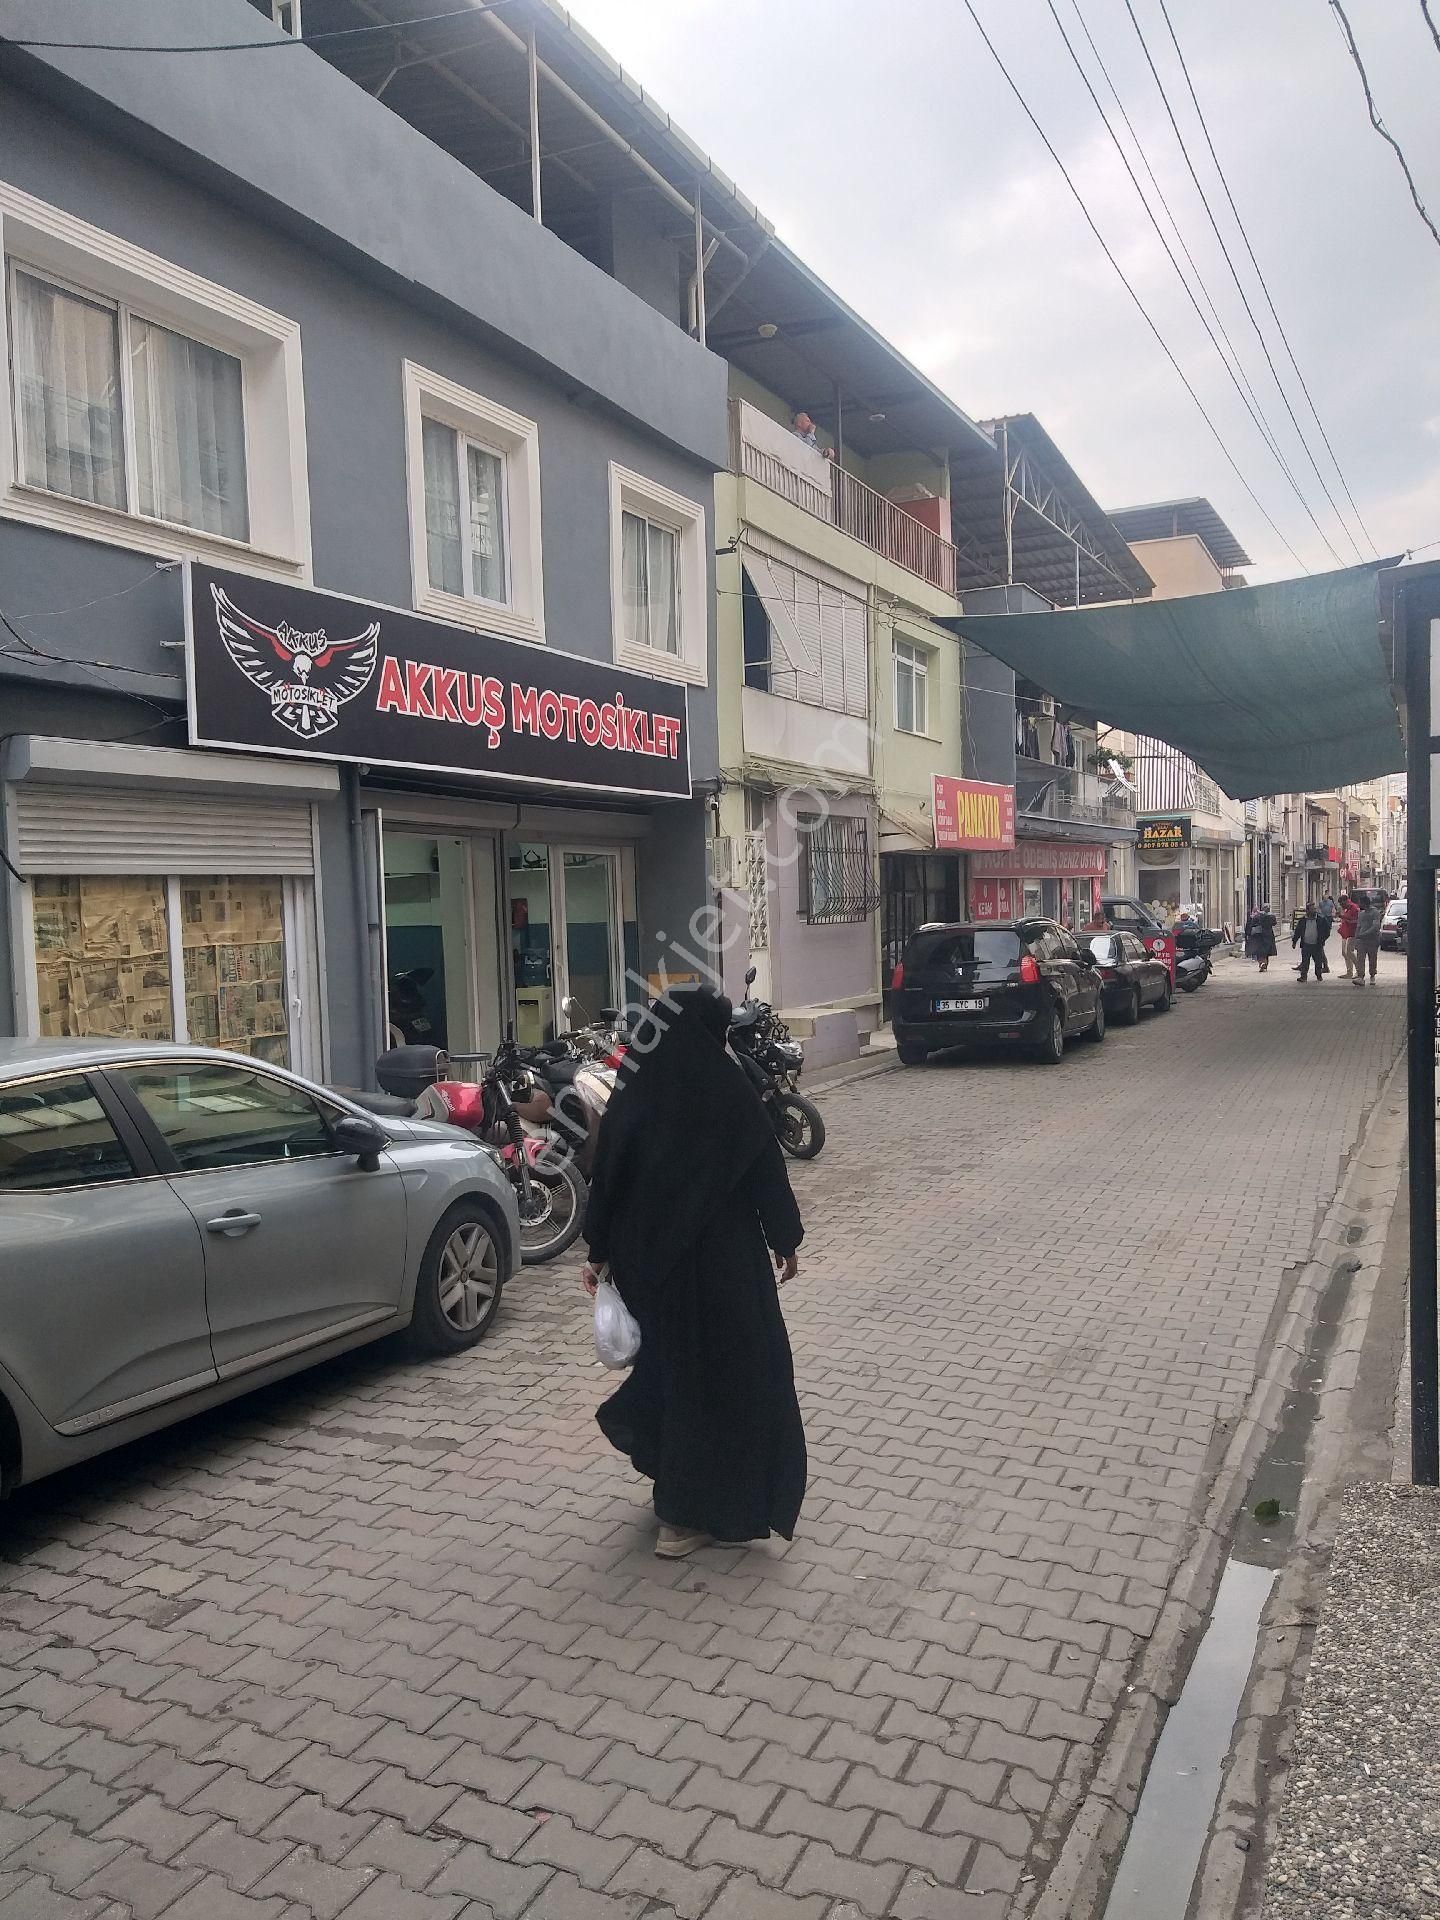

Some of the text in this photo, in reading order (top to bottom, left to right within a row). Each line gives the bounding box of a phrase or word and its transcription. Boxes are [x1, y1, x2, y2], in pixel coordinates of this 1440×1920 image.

[377, 655, 681, 760] AKKUŞ MOTOSİKLET
[1143, 828, 1183, 839] HAZAR
[941, 1000, 950, 1009] 35
[974, 999, 983, 1008] 19
[72, 1407, 108, 1424] CLIO
